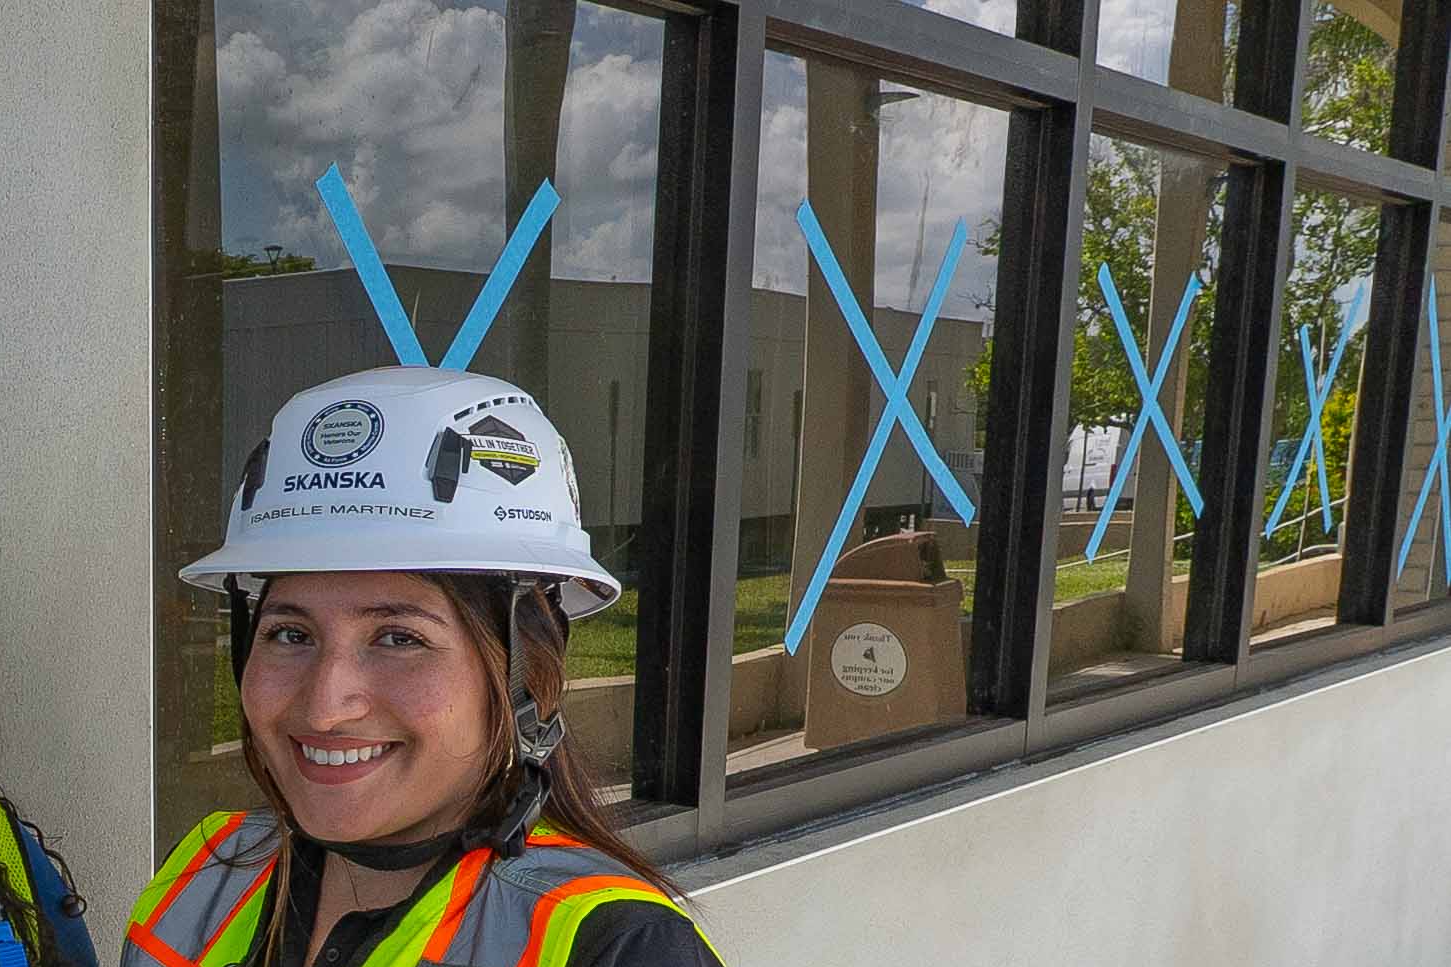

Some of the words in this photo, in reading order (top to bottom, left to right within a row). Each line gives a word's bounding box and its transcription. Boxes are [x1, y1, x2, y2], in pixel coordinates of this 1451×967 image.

[486, 439, 497, 449] IN
[496, 440, 536, 456] TOGETHER
[283, 471, 386, 493] SKANSKA
[250, 505, 324, 525] ISABELLE
[330, 504, 436, 520] MARTINEZ
[508, 508, 552, 521] STUDSON
